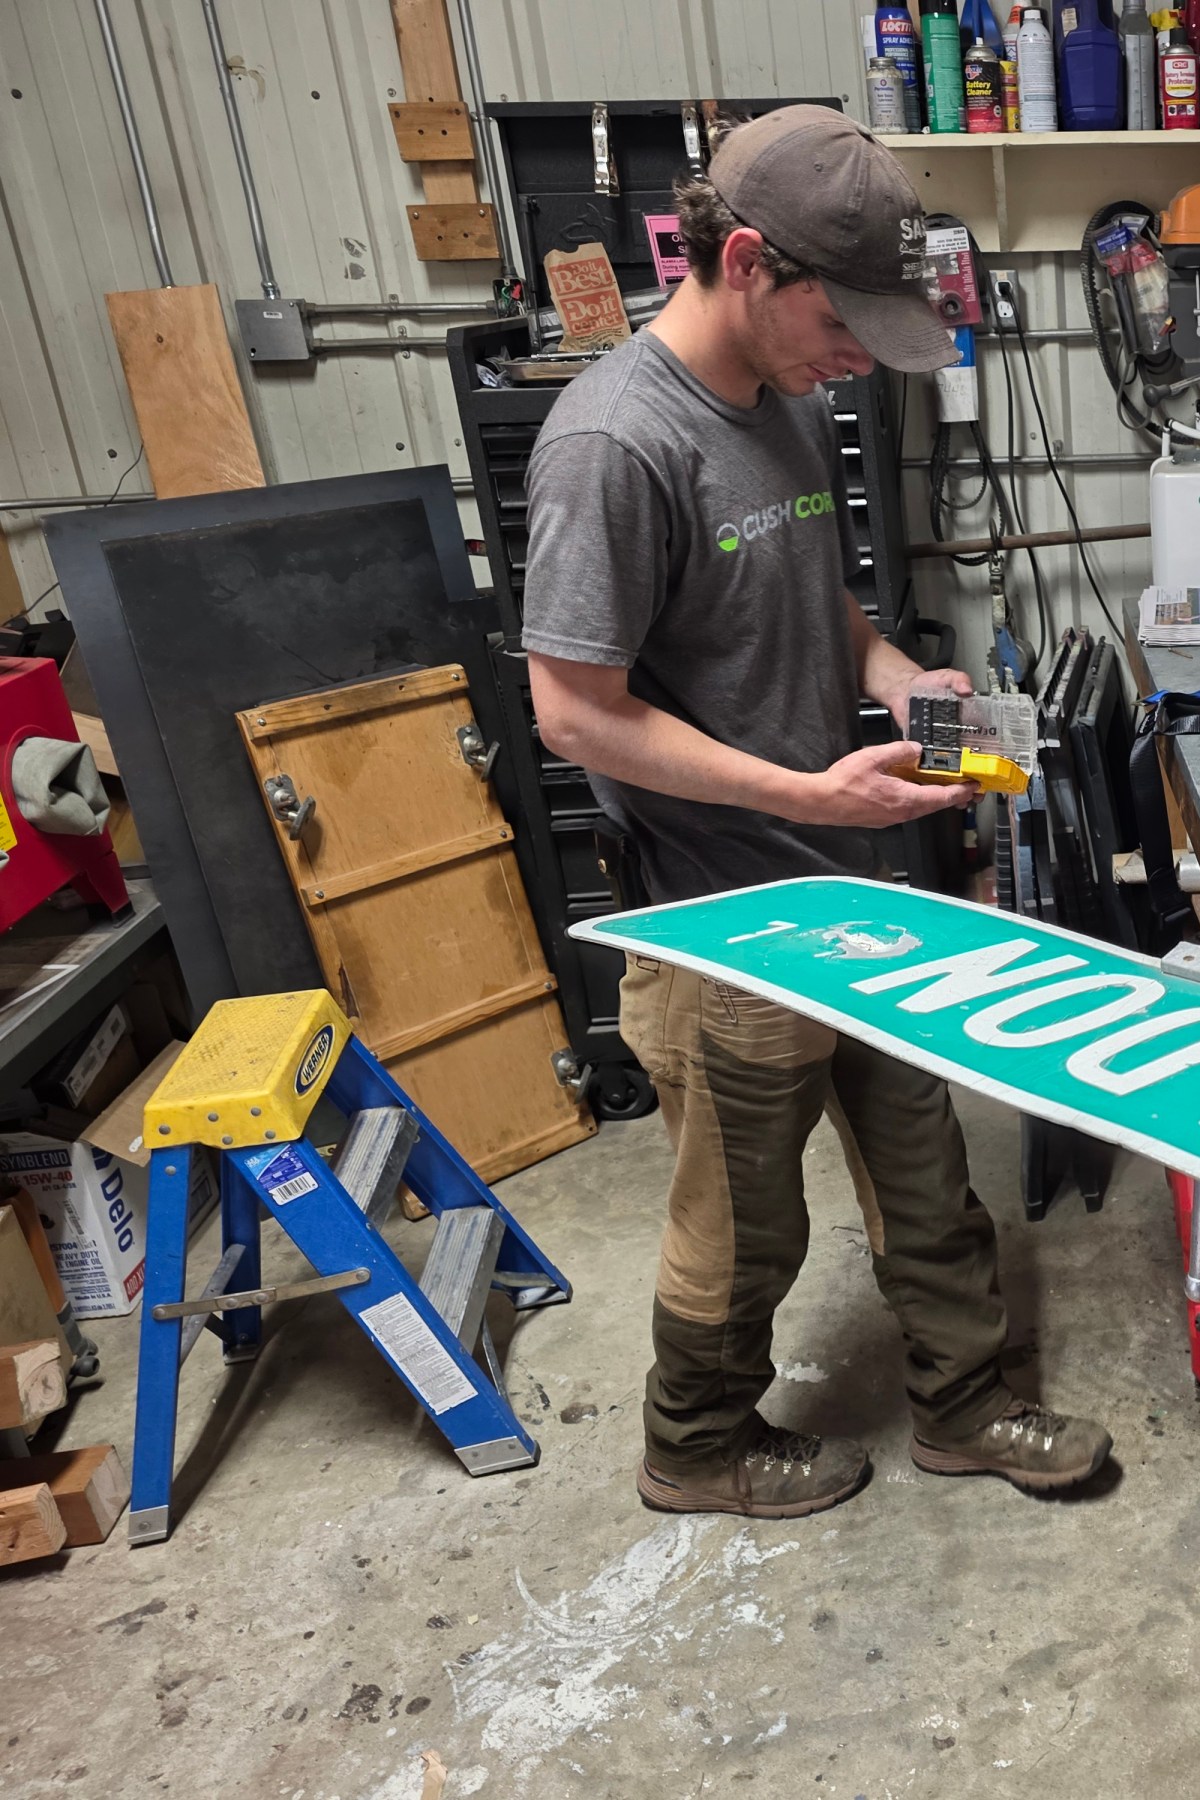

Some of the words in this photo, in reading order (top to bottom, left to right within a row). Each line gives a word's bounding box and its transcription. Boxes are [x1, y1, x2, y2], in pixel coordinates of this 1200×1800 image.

[966, 81, 991, 89] Battery
[966, 88, 993, 96] Cleaner
[552, 266, 611, 294] Best
[600, 294, 617, 315] it
[571, 314, 619, 333] center
[742, 500, 791, 540] CUSH
[795, 491, 836, 519] COR
[302, 1034, 329, 1082] WERNER
[1, 1151, 69, 1171] SYNBLEND
[24, 1170, 73, 1186] 15W-40
[101, 1168, 133, 1253] Delo
[57, 1252, 79, 1262] HEAVY
[80, 1250, 99, 1260] DUTY
[65, 1259, 90, 1268] ENGINE
[91, 1257, 102, 1266] OIL
